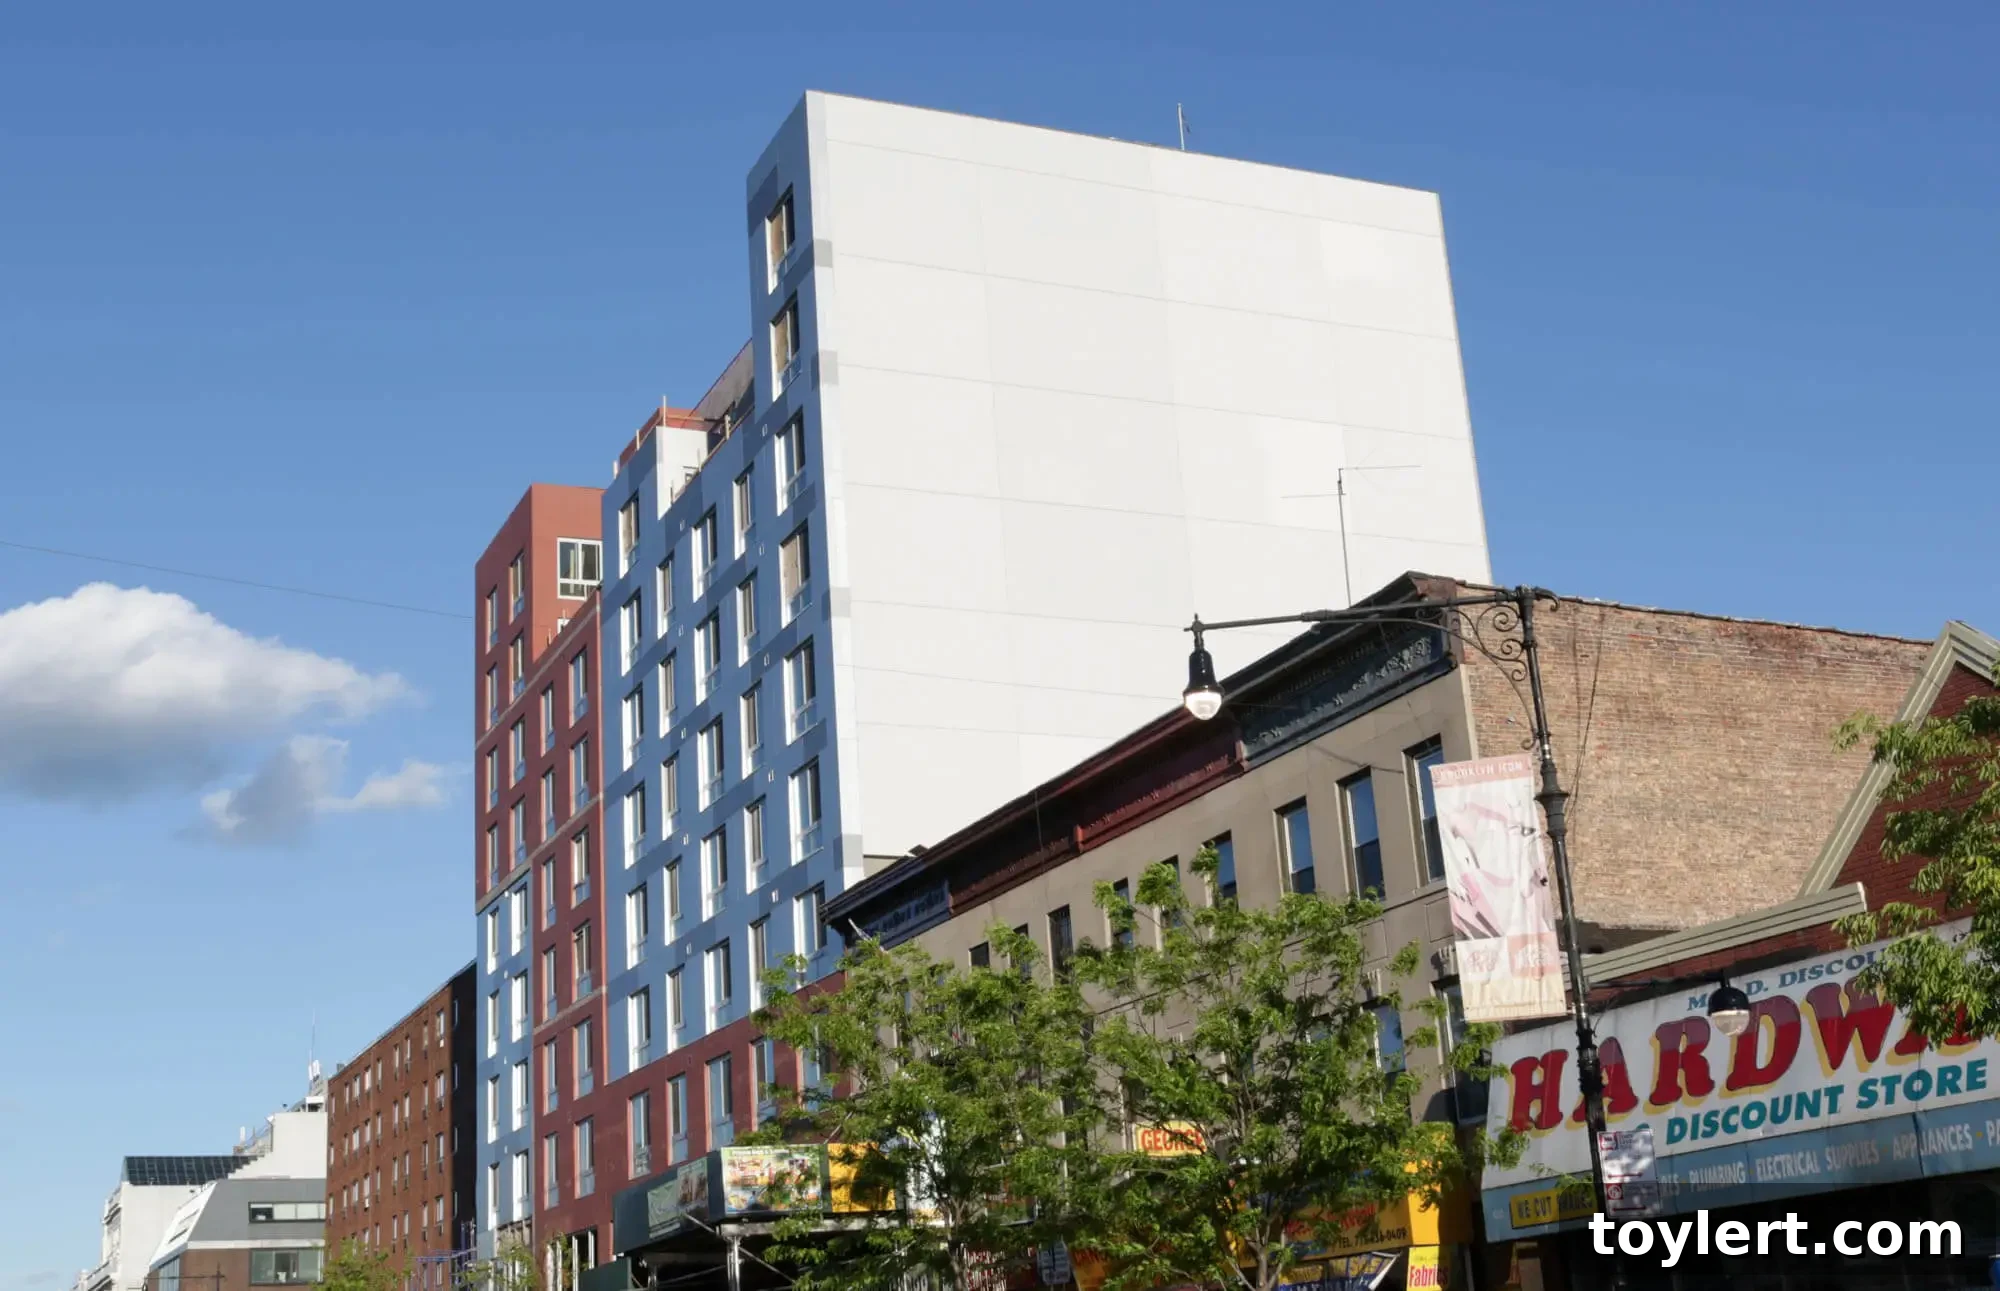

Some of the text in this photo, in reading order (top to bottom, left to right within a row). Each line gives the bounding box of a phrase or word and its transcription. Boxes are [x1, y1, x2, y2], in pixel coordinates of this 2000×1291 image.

[1666, 1058, 1988, 1144] DISCOUNT STORE
[1688, 1161, 1746, 1193] PLUMBING
[1755, 1149, 1821, 1182] ELECTRICAL
[1825, 1139, 1880, 1171] SUPPLIES
[1892, 1123, 1973, 1161] APPLIANCES
